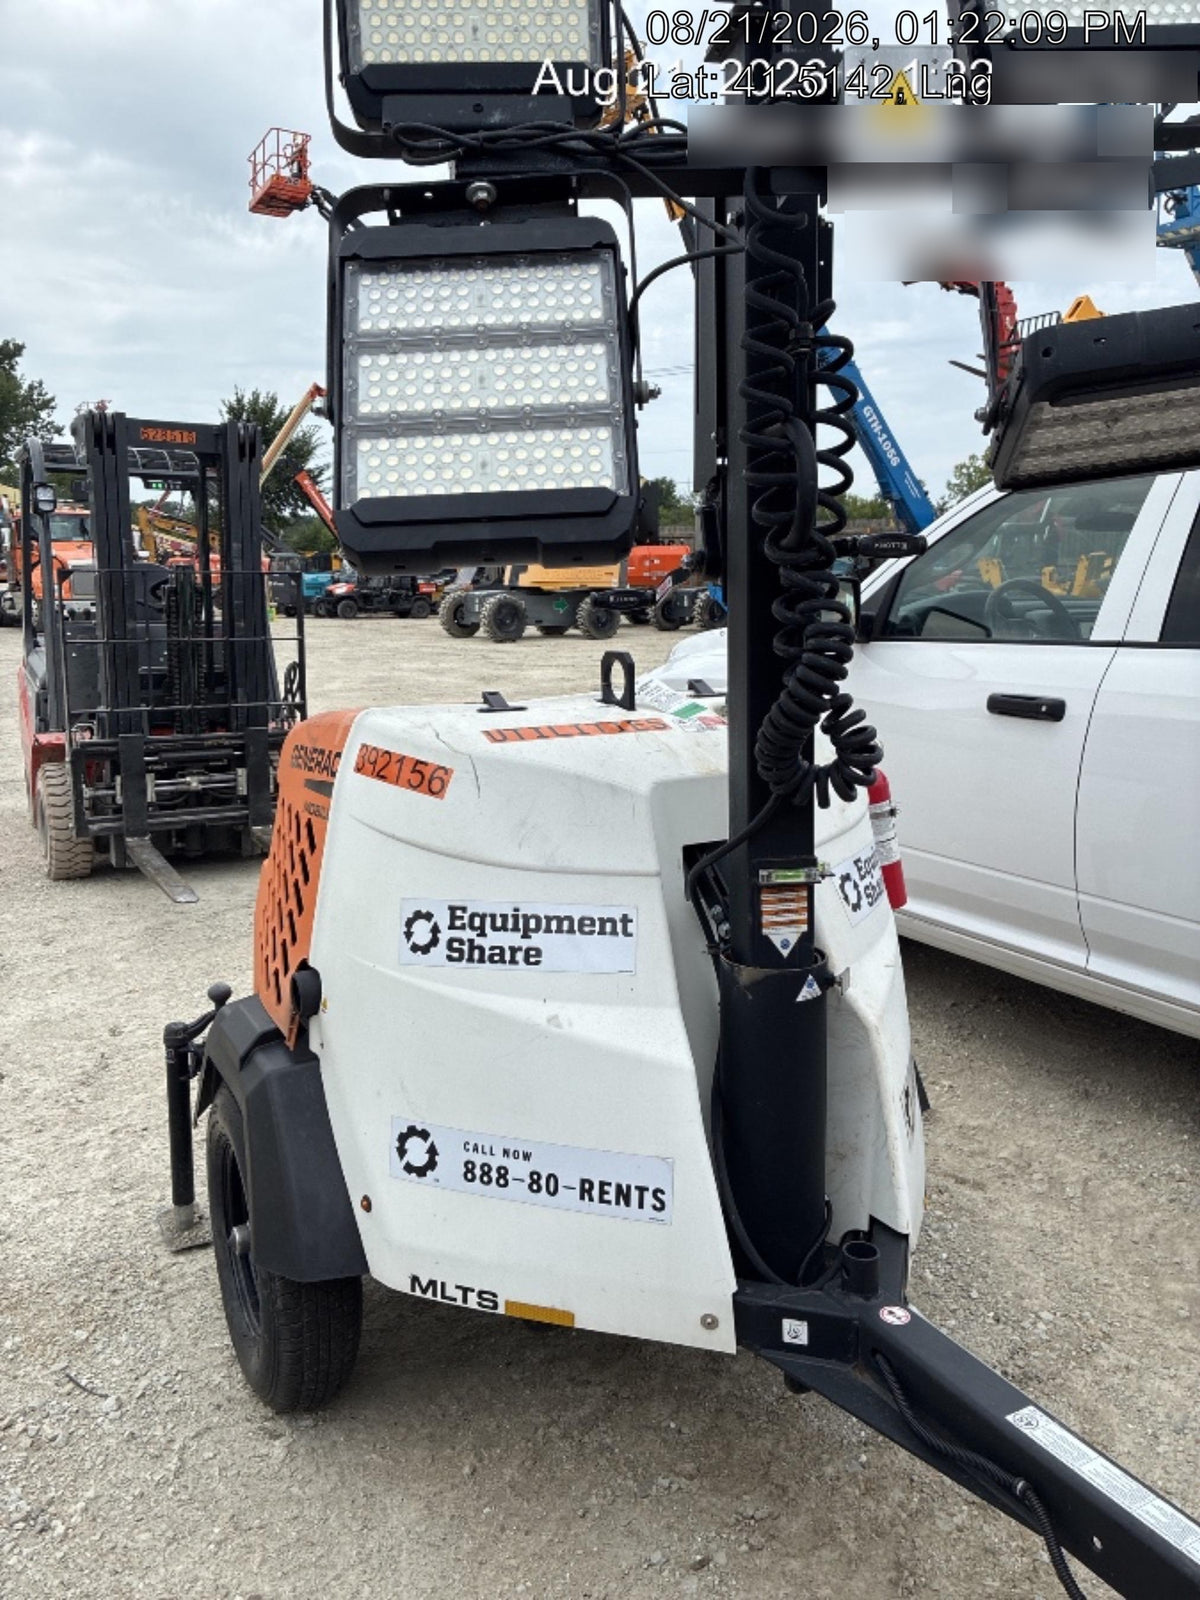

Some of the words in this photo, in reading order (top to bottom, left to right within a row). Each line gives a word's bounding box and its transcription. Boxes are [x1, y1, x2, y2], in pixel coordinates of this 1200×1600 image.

[863, 405, 900, 467] GTH-1056
[355, 743, 450, 796] 392156
[447, 904, 635, 939] Equipment
[445, 936, 543, 967] Share
[463, 1140, 496, 1158] CALL
[502, 1147, 533, 1163] NOW
[462, 1159, 667, 1213] 888-80-RENTS
[408, 1273, 499, 1311] MLTS
